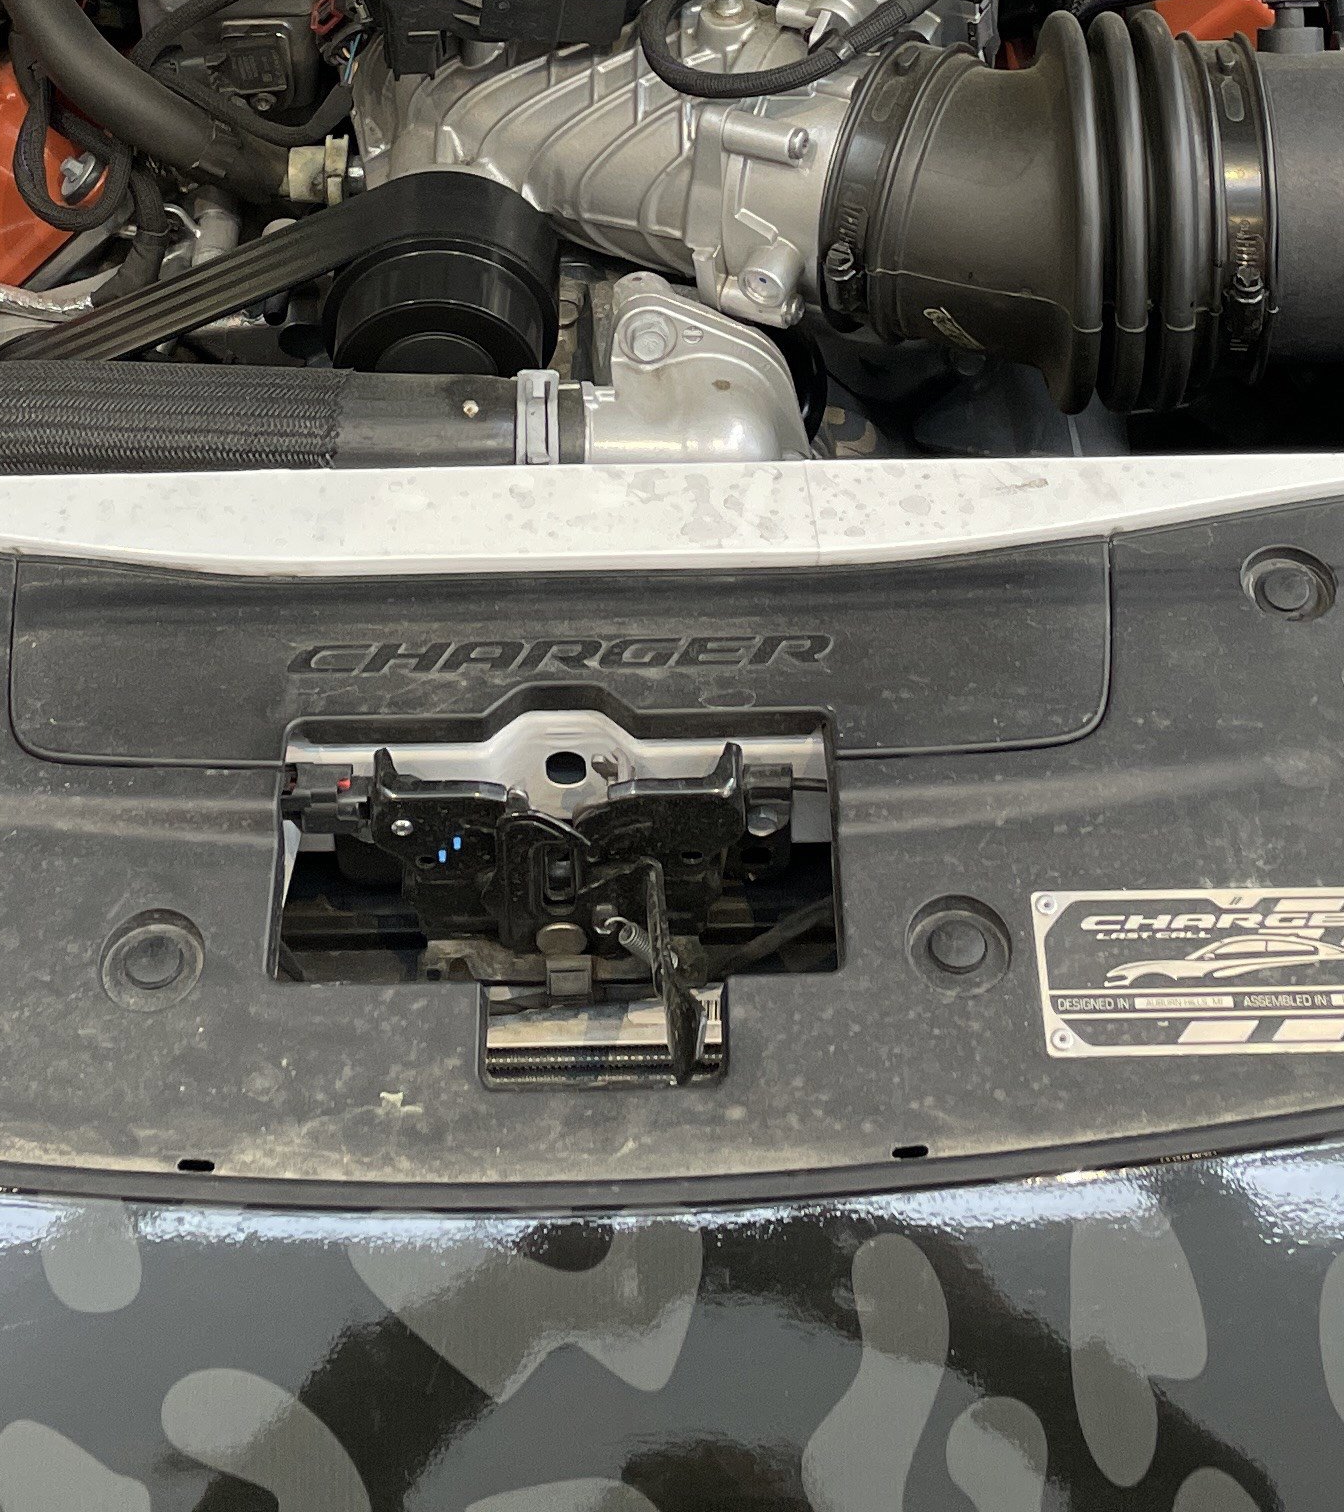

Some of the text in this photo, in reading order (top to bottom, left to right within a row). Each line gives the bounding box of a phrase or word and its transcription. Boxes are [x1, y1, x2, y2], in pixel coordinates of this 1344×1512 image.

[288, 633, 834, 676] CHARGER
[1096, 930, 1212, 940] LAST CALL
[1058, 997, 1115, 1011] DESIGNED
[1117, 997, 1130, 1010] IN
[1243, 994, 1312, 1007] ASSEMBLED
[1314, 994, 1327, 1006] IN
